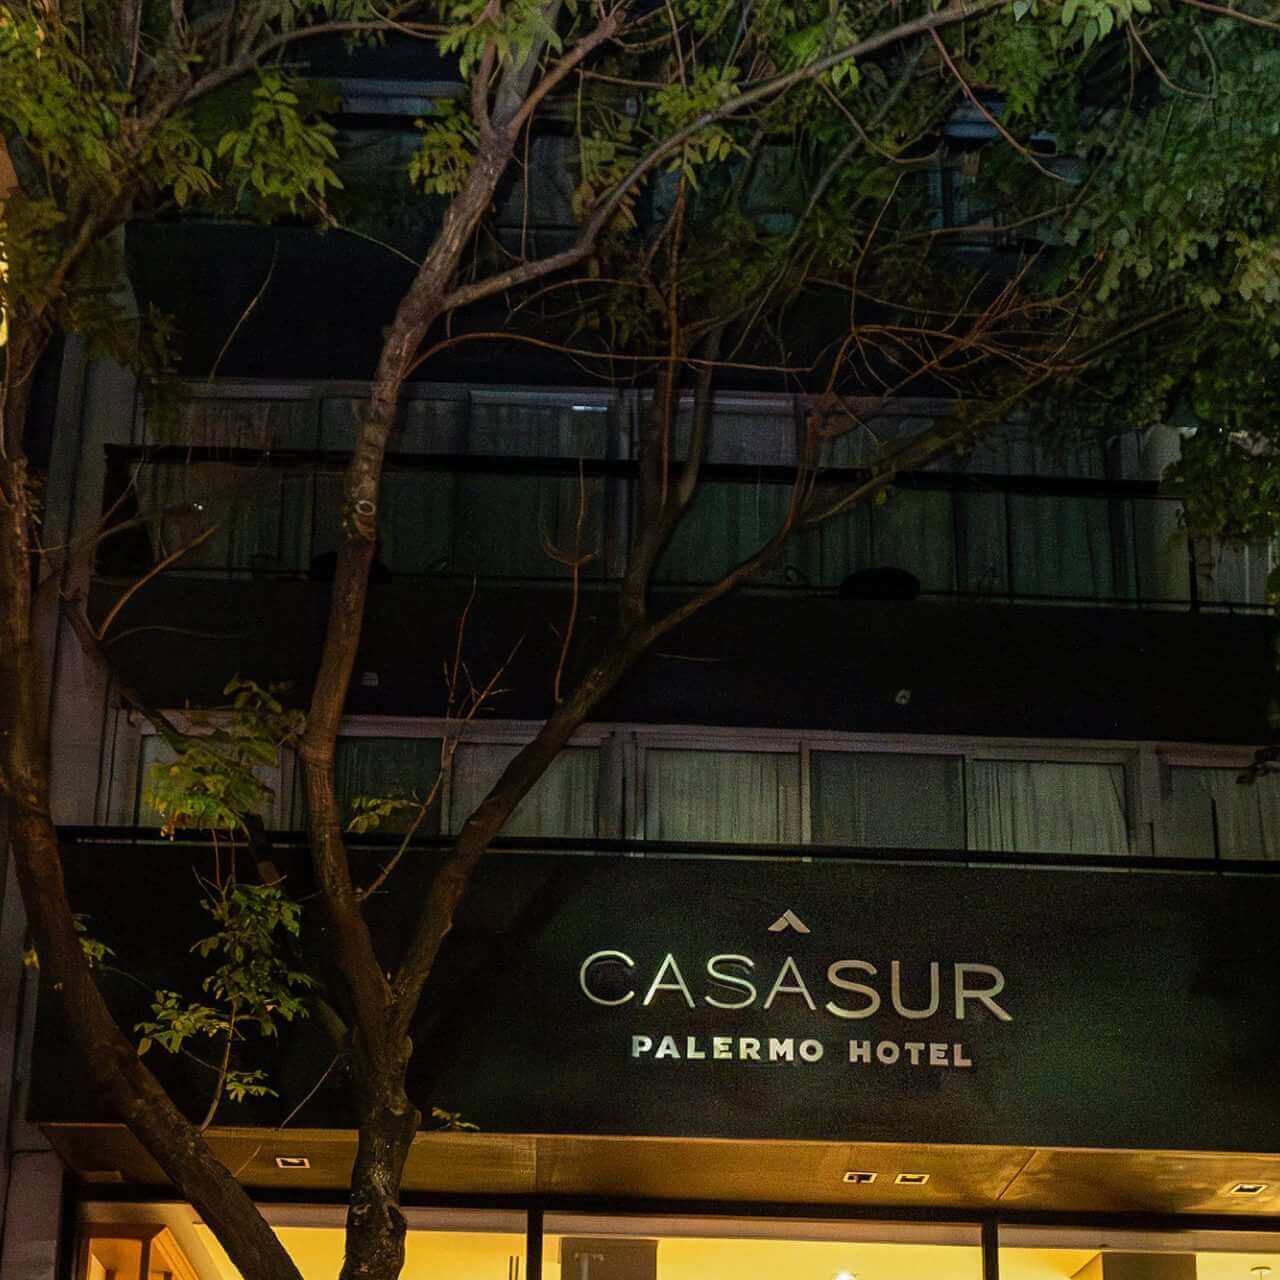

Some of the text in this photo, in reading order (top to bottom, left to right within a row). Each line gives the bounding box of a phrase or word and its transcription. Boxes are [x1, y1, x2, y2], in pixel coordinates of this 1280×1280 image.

[579, 949, 1013, 1022] CASASUR
[631, 1035, 973, 1067] PALERMO HOTEL
